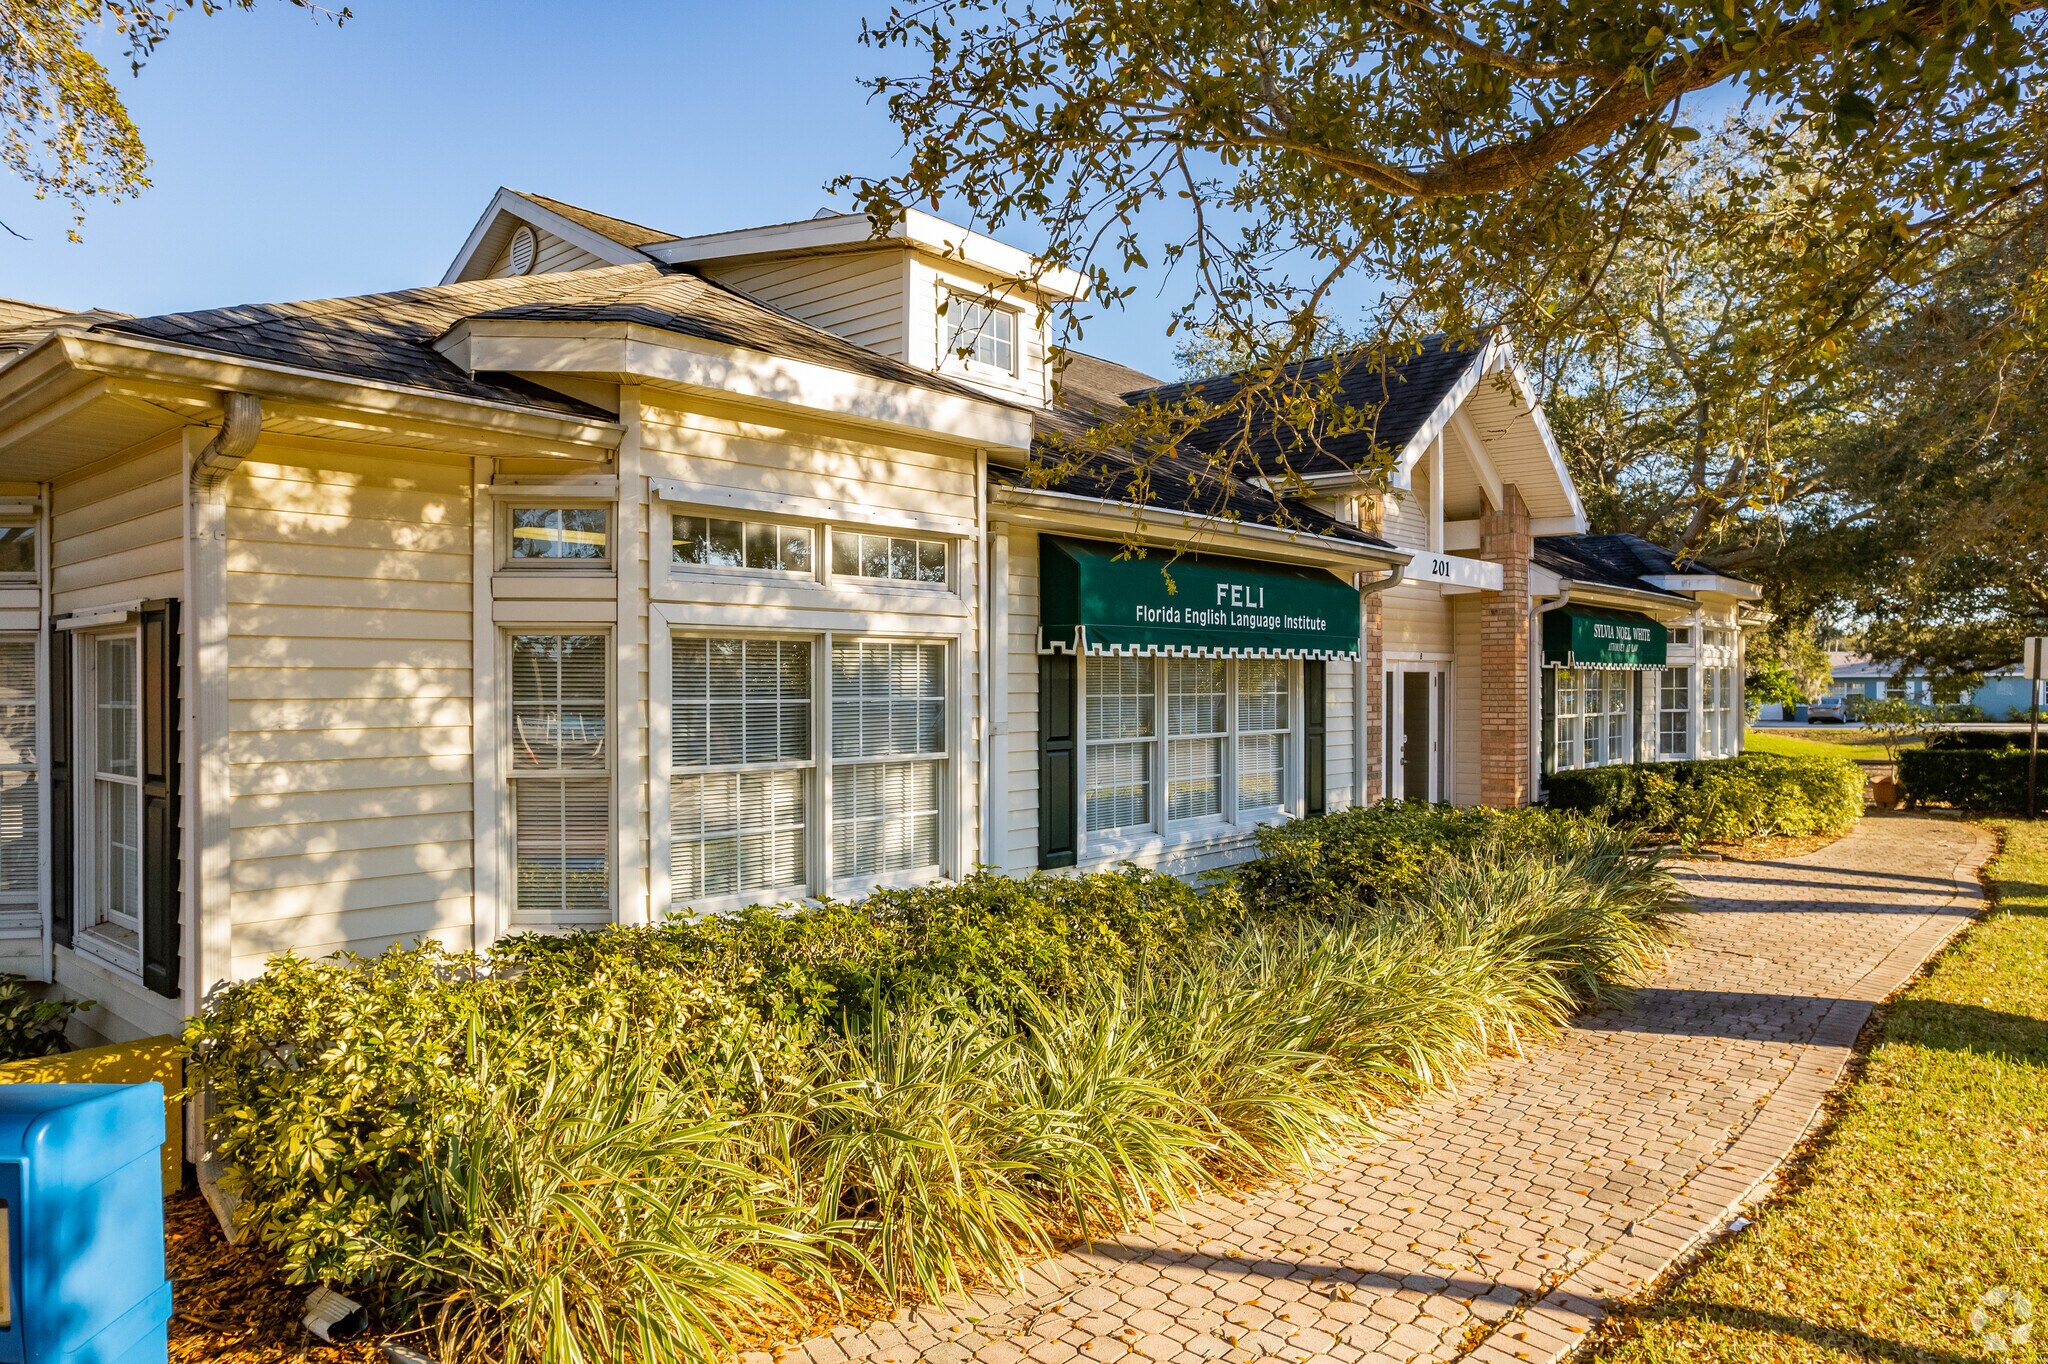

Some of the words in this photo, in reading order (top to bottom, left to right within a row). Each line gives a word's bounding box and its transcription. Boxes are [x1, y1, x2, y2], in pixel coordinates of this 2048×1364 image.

[1432, 559, 1450, 577] 201
[1216, 583, 1264, 608] FELI
[1136, 605, 1181, 623] Florida
[1185, 607, 1227, 626] English
[1230, 610, 1281, 630] Language
[1284, 614, 1327, 631] Institute
[1594, 624, 1614, 638] SYLVIA
[1616, 626, 1631, 640] NOEL
[1633, 628, 1650, 641] WHITE
